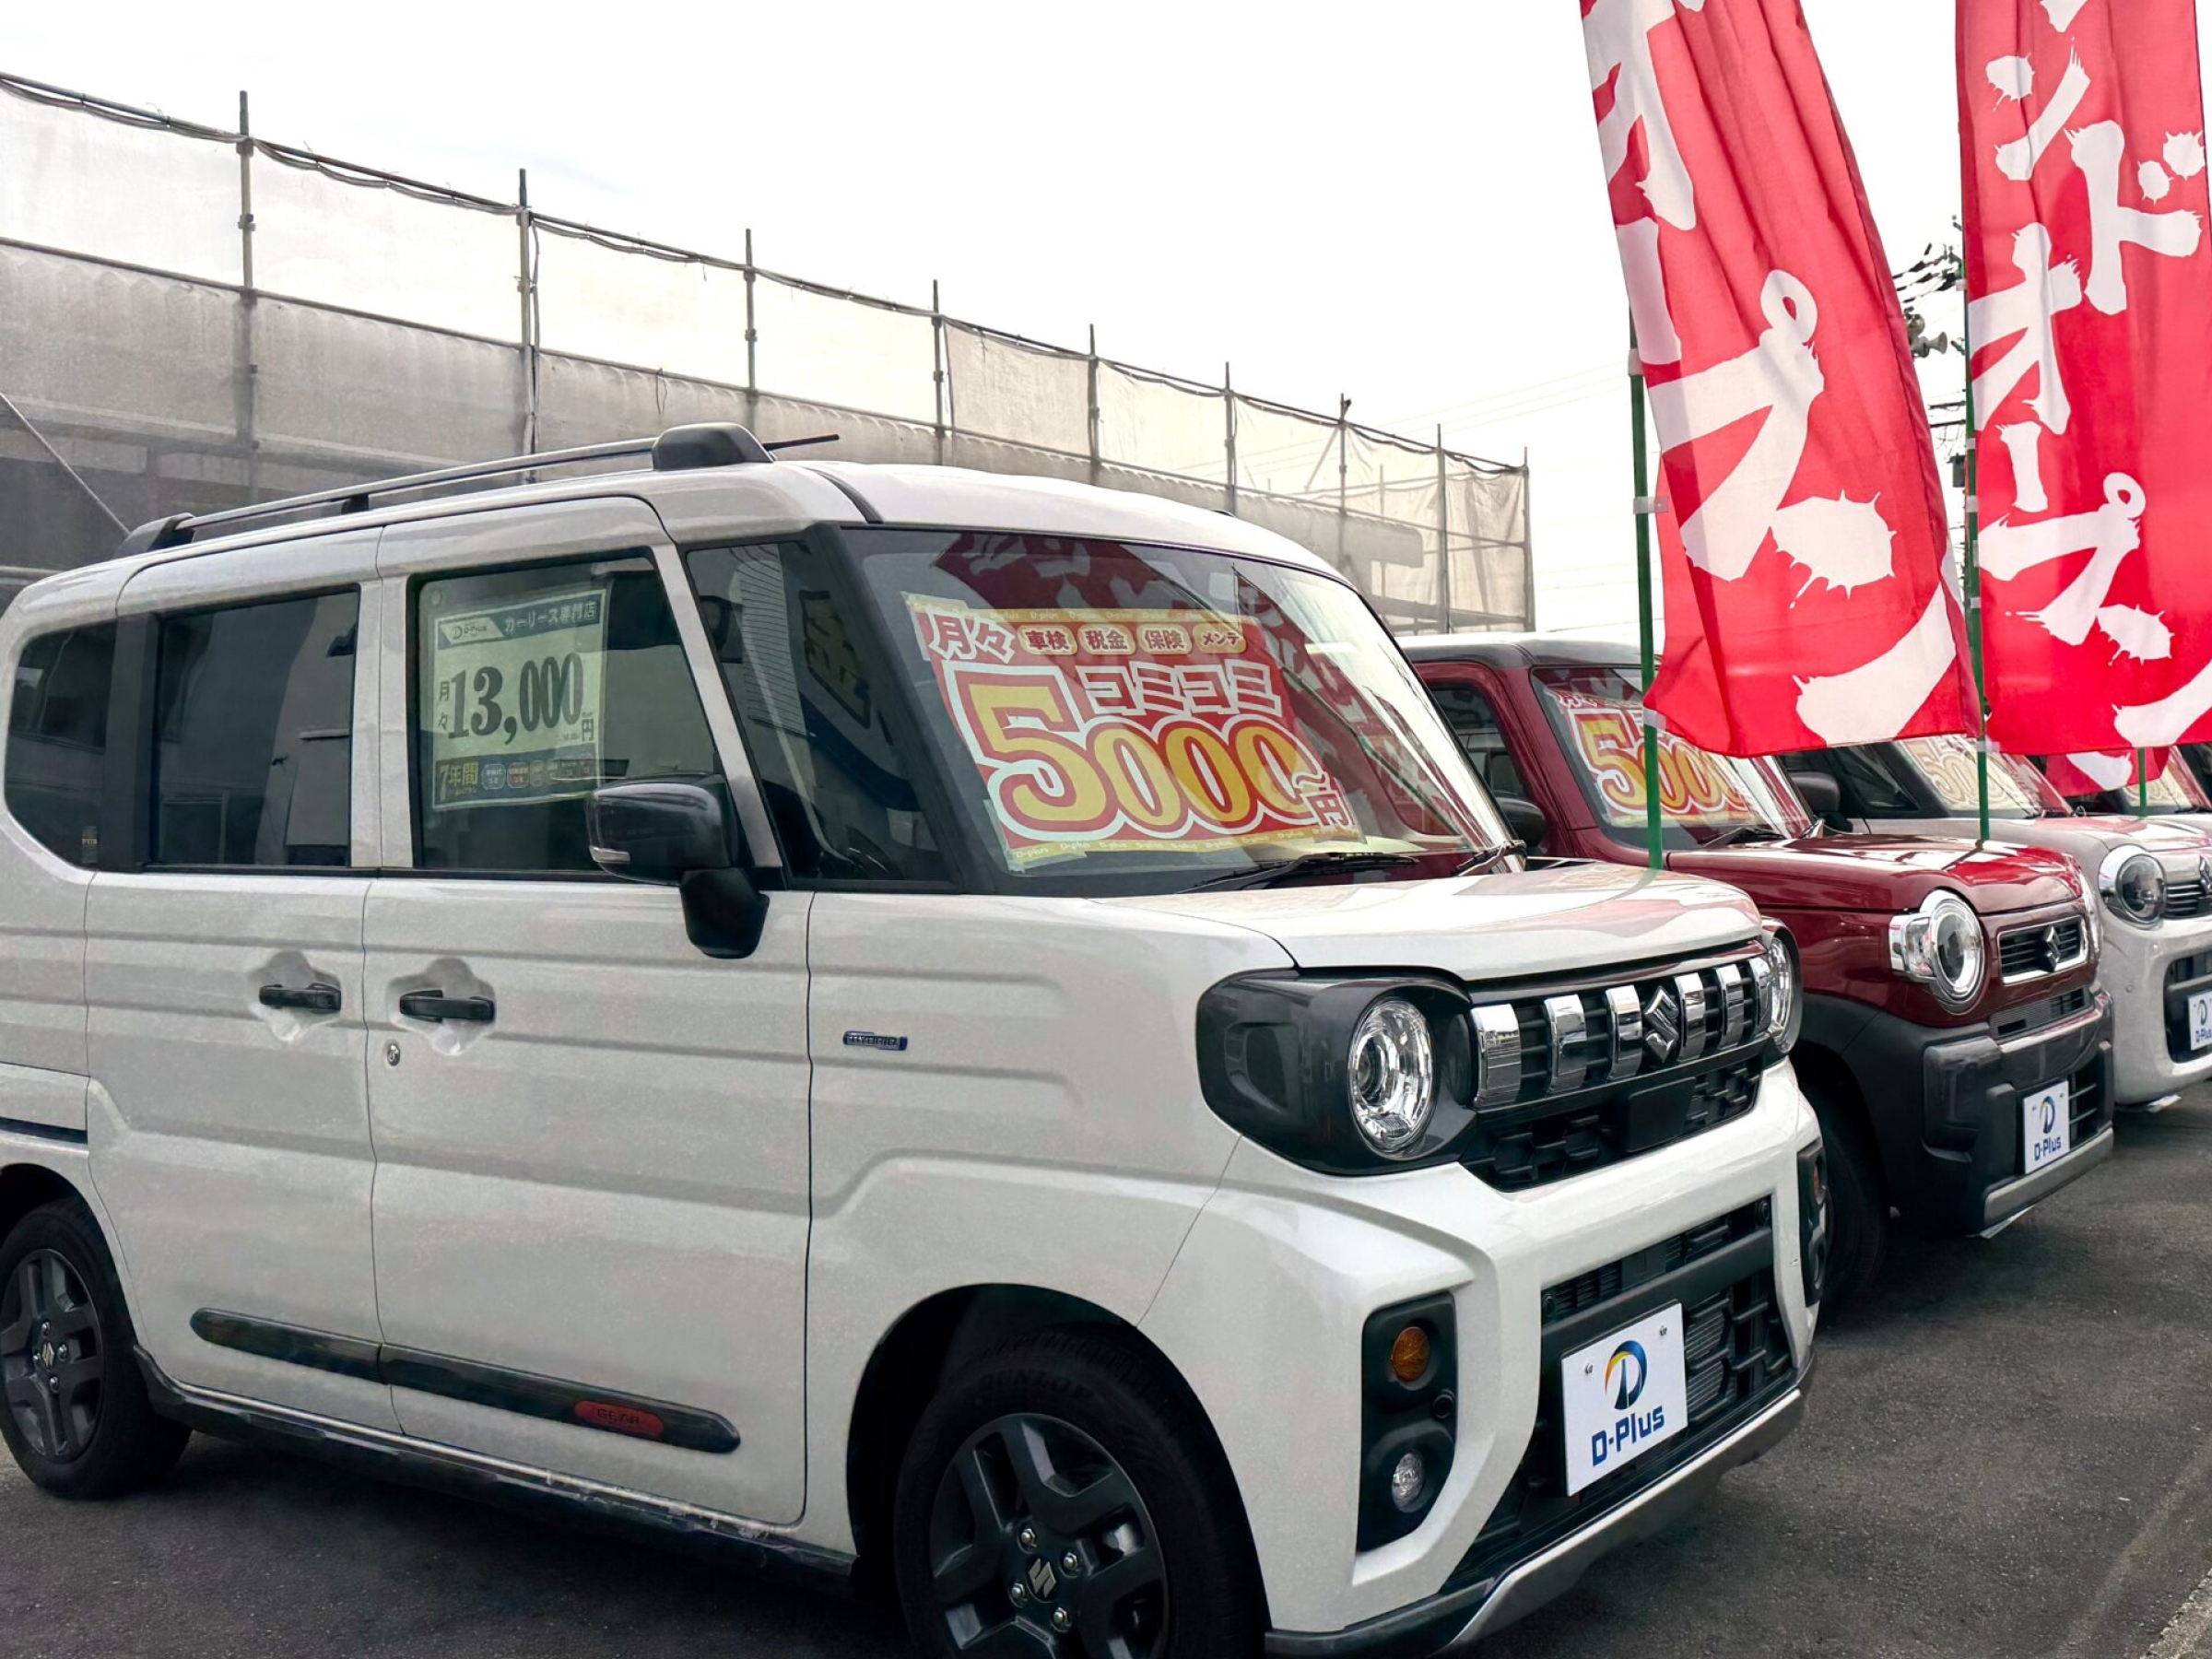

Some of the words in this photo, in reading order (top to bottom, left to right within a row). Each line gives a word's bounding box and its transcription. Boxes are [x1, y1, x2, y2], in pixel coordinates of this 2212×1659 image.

[928, 608, 1016, 664] 月々
[1025, 629, 1070, 651] 車検
[1085, 629, 1128, 651] 税金
[1144, 629, 1185, 650] 保険
[438, 680, 450, 731] 月々
[449, 653, 584, 745] 13,000
[582, 718, 595, 743] 円
[1076, 659, 1283, 717] コミコミ
[943, 661, 1322, 840] 5000
[2033, 1135, 2062, 1162] D-Plus
[1591, 1405, 1665, 1467] D-Plus
